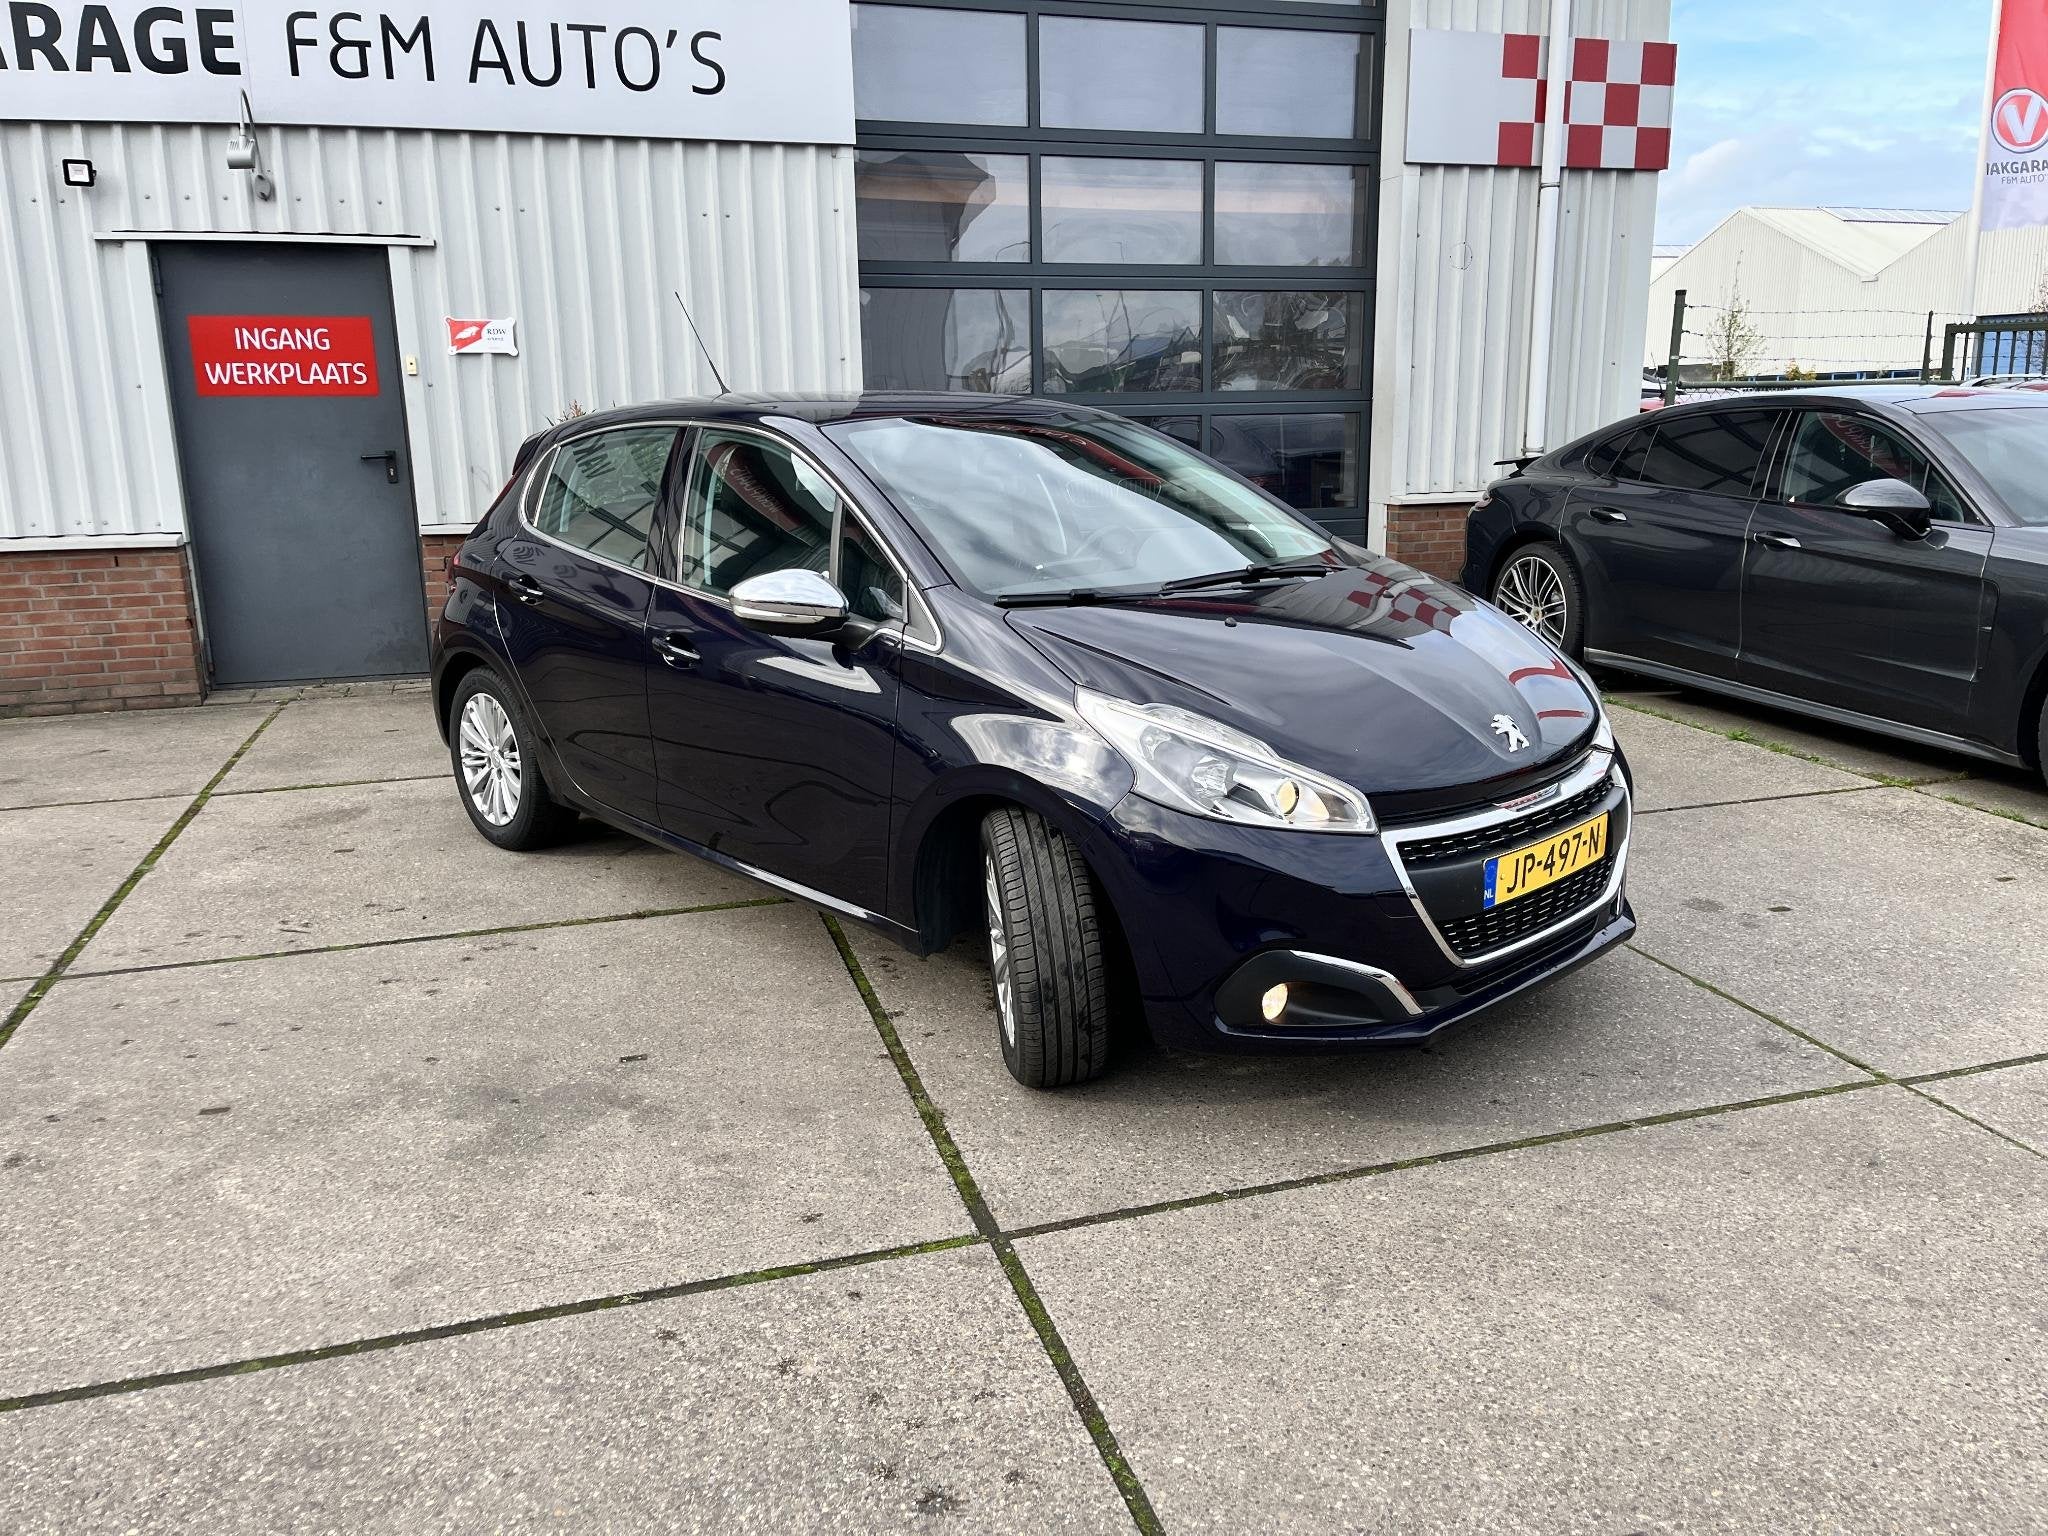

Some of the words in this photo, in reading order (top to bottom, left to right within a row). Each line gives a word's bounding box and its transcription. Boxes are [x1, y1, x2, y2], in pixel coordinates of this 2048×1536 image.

[0, 1, 242, 76] RAGE
[286, 11, 436, 83] F&M
[468, 19, 727, 96] AUTO'S
[234, 327, 331, 351] INGANG
[204, 362, 368, 386] WERKPLAATS
[1506, 822, 1601, 894] JP-497-N
[1484, 888, 1494, 900] NL
